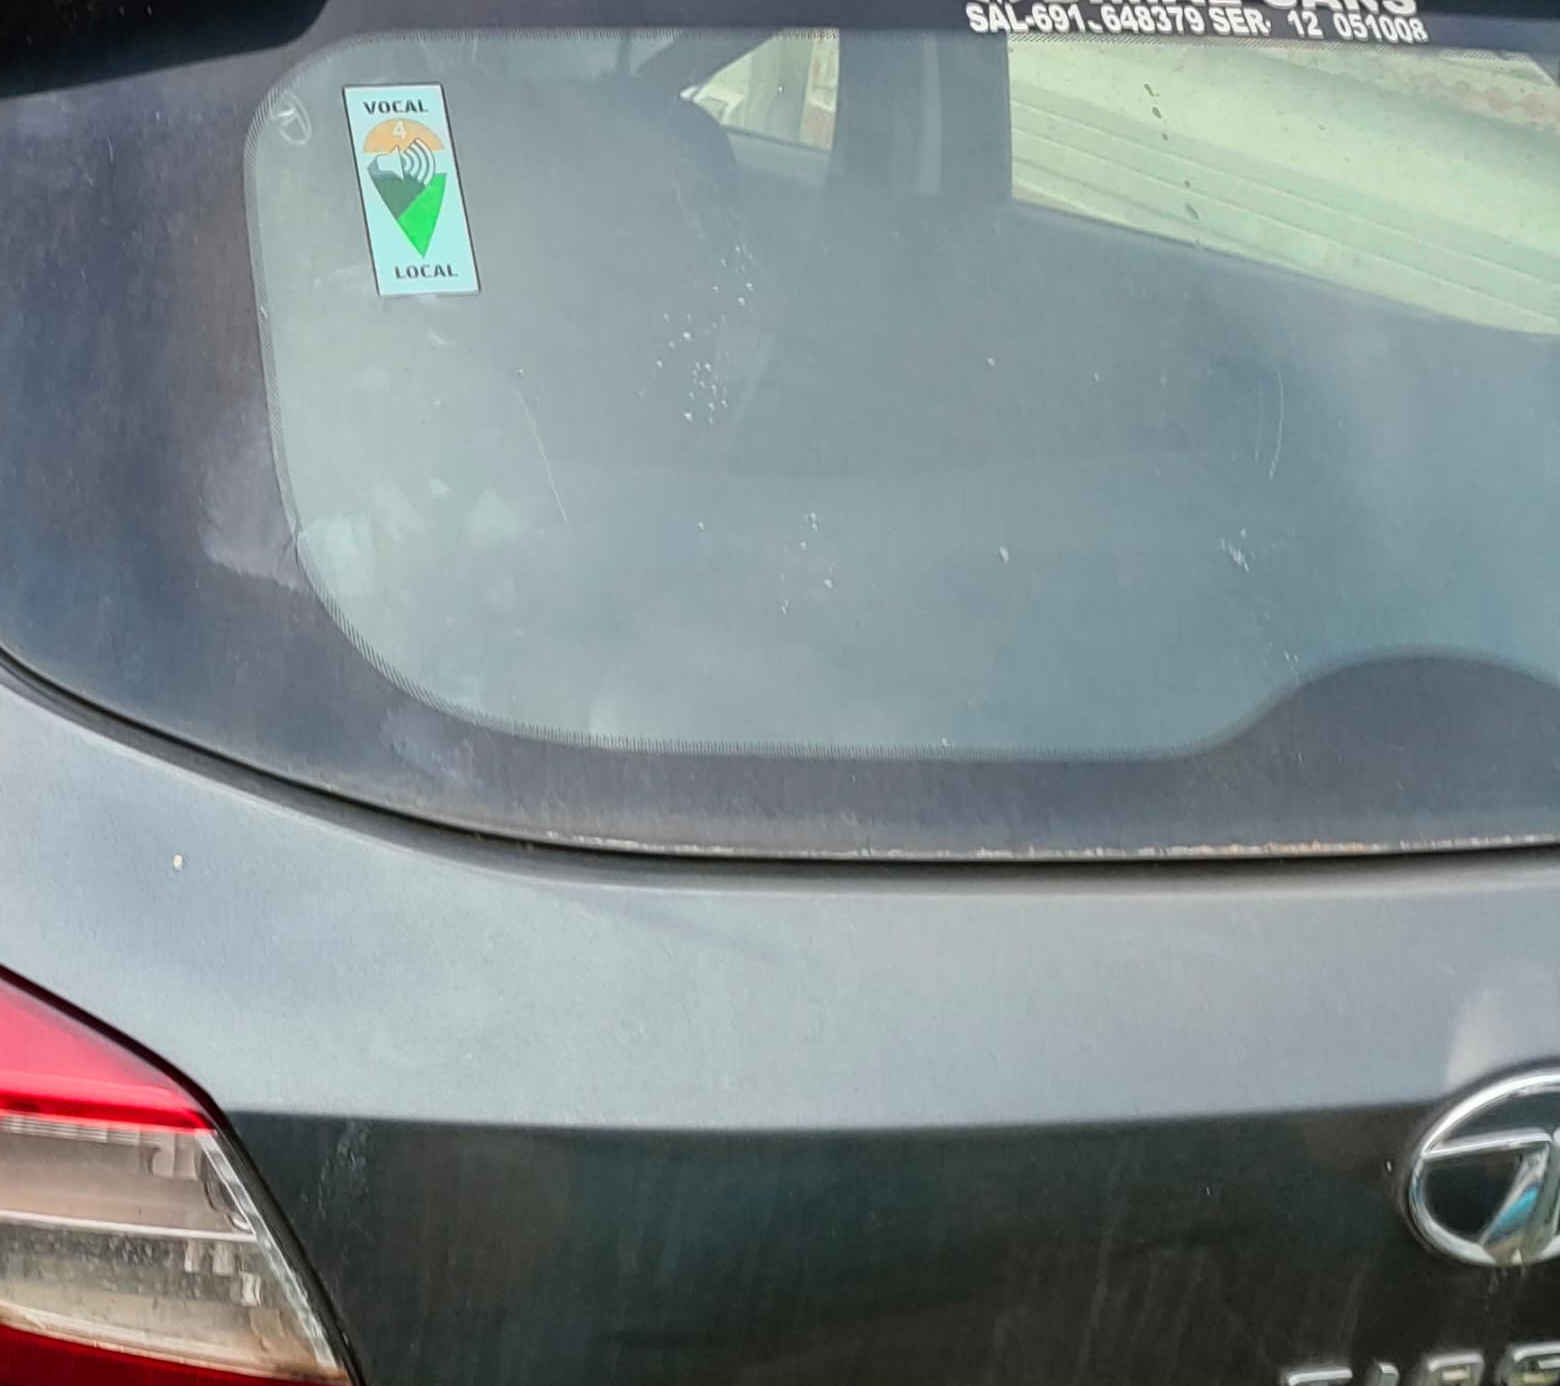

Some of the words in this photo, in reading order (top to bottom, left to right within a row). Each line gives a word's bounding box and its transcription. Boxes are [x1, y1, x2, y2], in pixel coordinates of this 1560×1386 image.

[1333, 13, 1429, 43] 051008
[363, 98, 429, 114] VOCAL
[392, 120, 407, 139] 4
[394, 263, 458, 280] LOCAL
